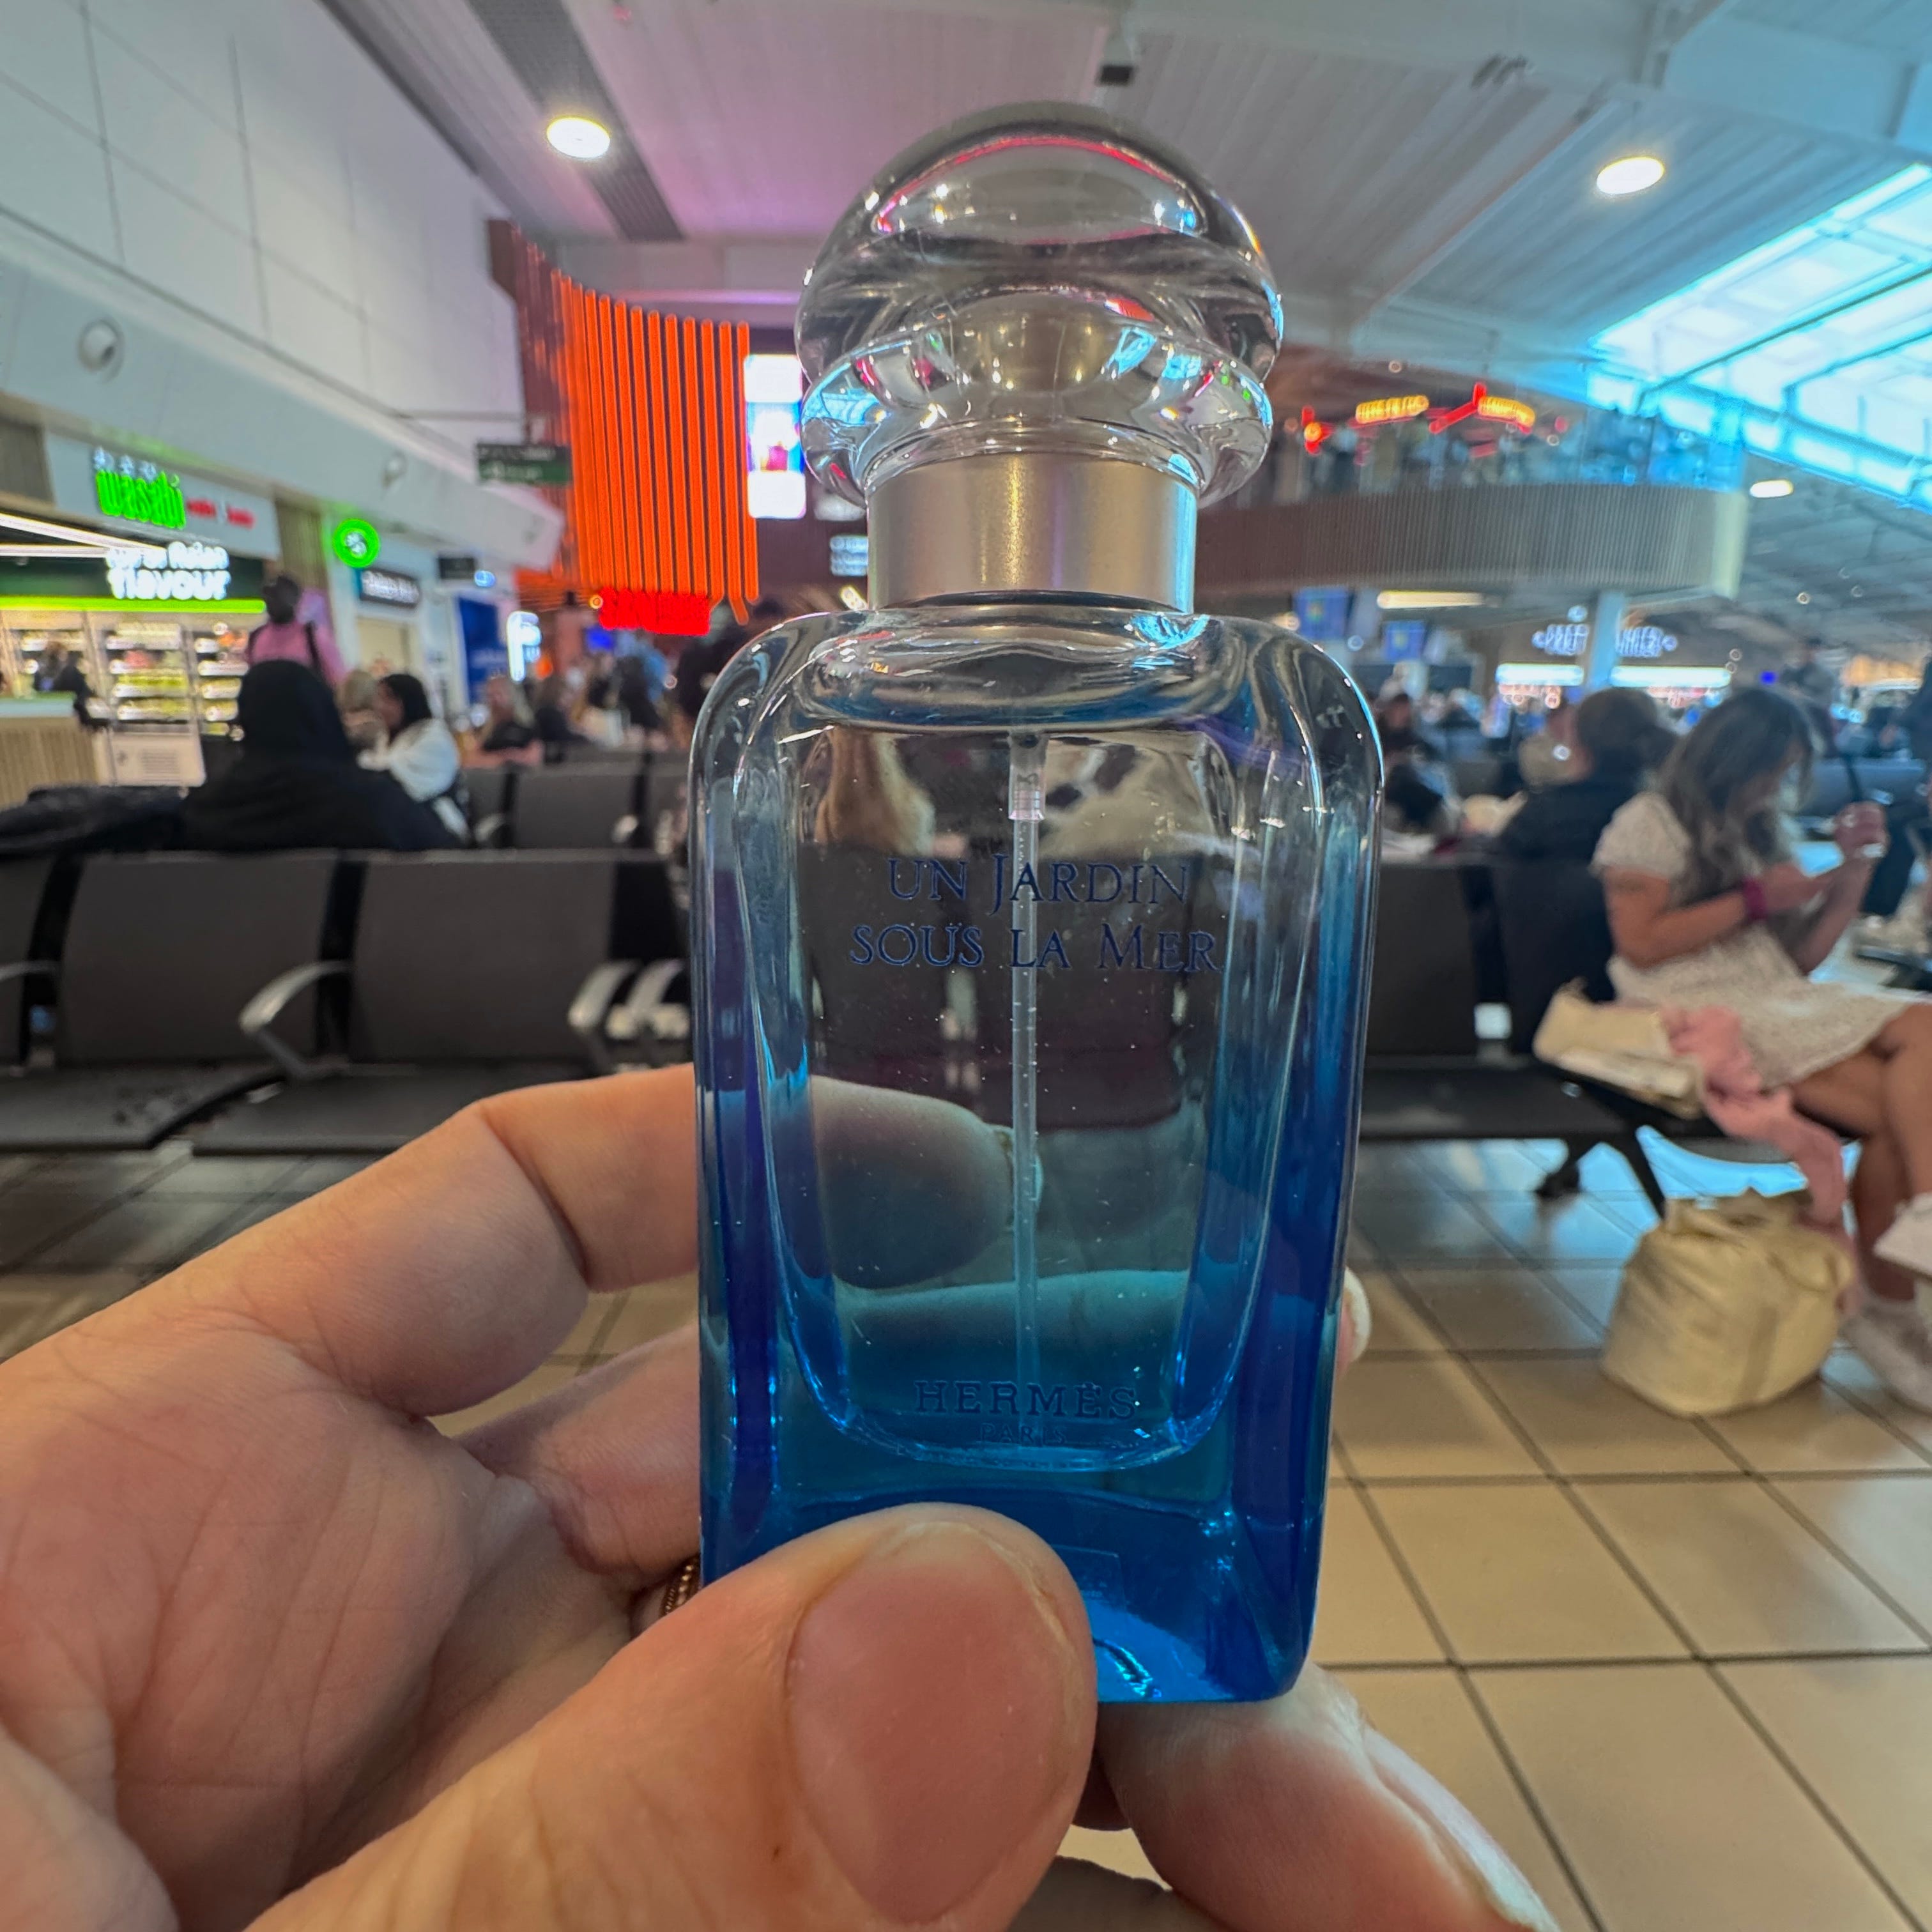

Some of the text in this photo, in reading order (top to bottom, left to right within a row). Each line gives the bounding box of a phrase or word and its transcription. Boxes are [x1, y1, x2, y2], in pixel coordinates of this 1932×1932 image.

[888, 853, 1192, 917] UN JARDIN
[850, 923, 1220, 972] SOUS LA MER
[979, 1423, 1067, 1447] PARIS
